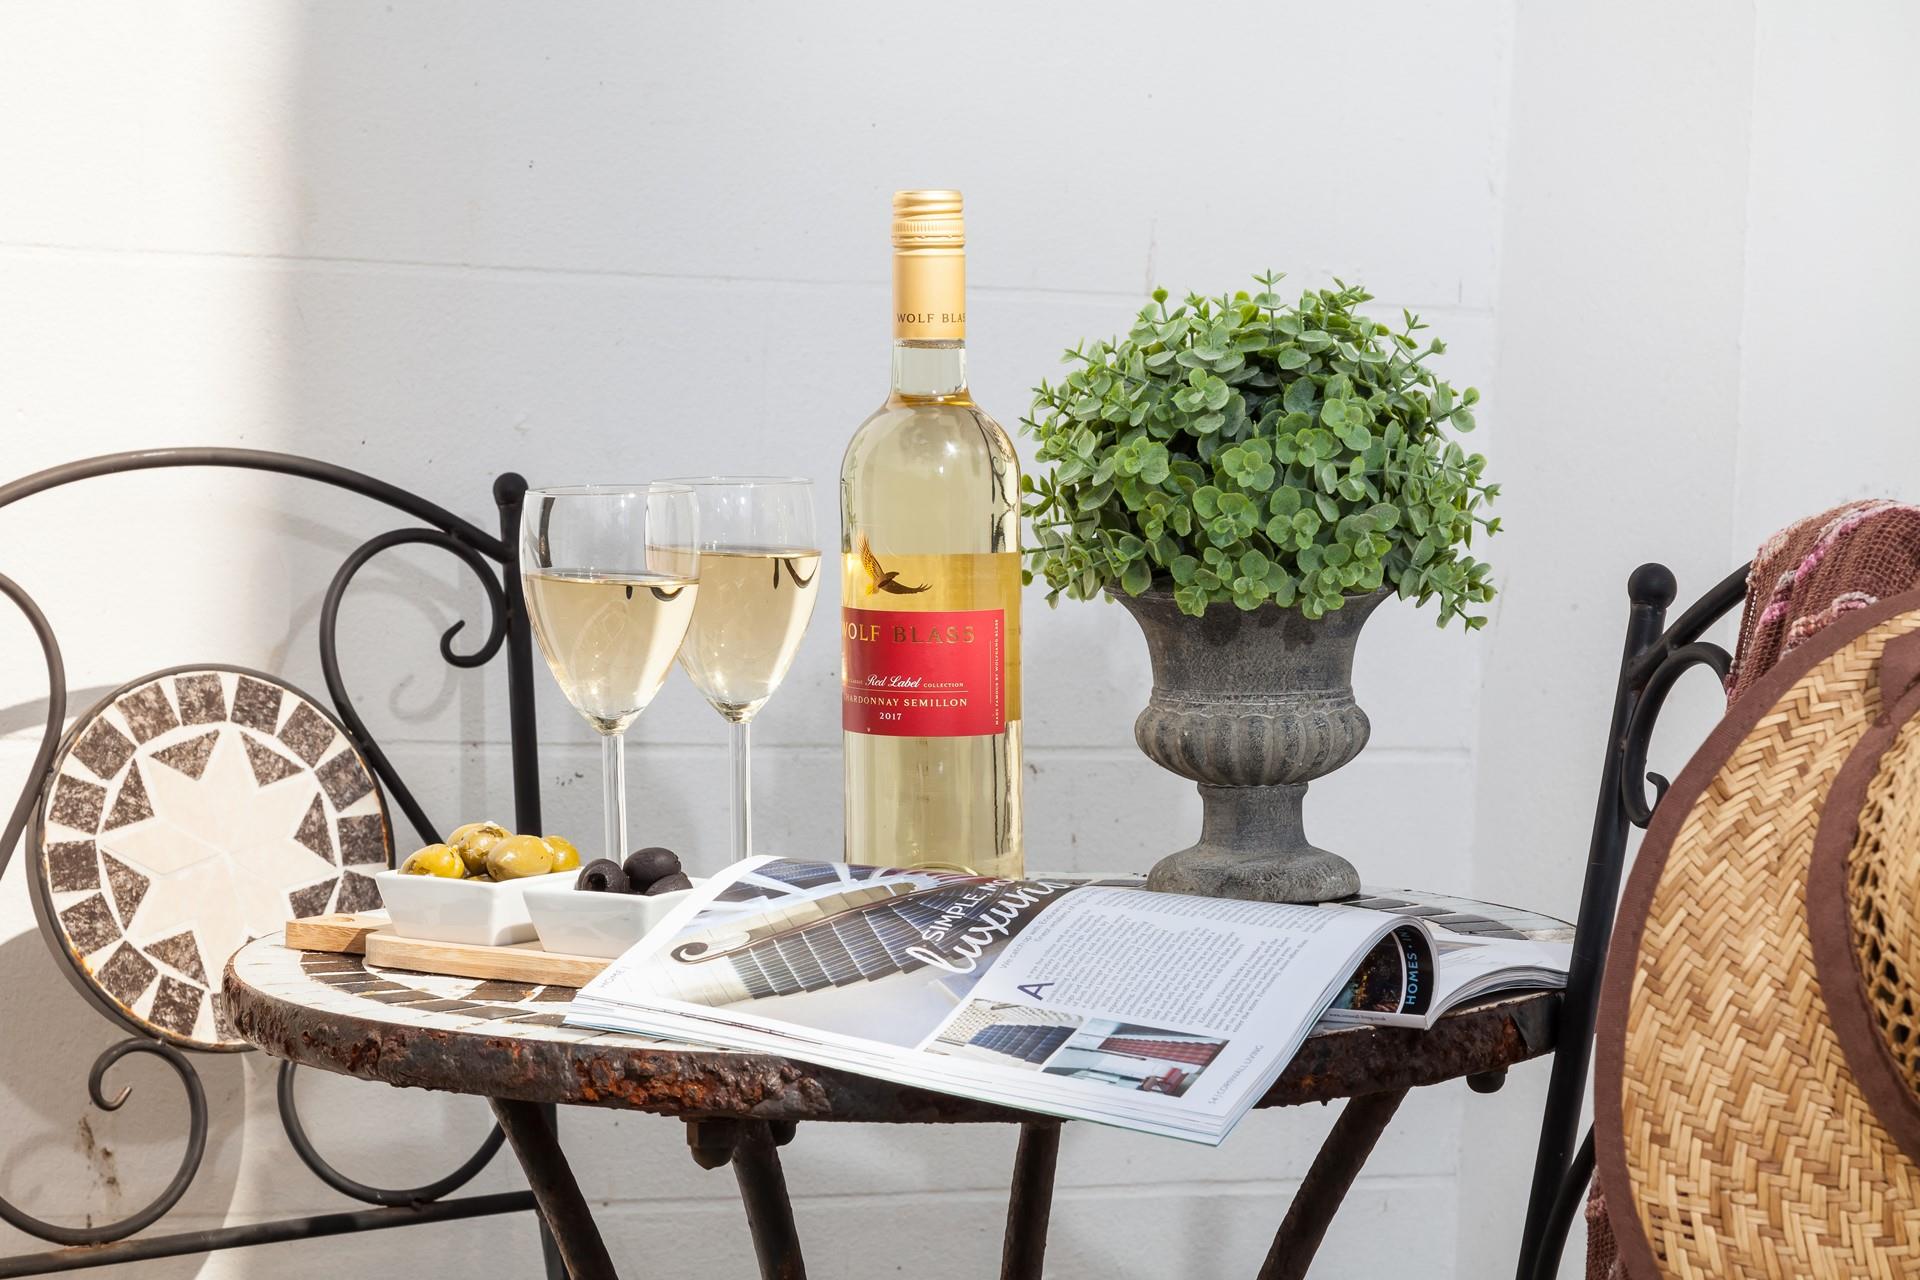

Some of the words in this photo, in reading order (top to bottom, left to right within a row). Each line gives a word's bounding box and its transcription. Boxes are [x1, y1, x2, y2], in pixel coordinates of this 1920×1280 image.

[897, 313, 935, 323] WOLF
[893, 626, 975, 644] BLASS
[865, 673, 887, 687] Red
[888, 674, 922, 688] Label
[843, 693, 899, 706] HARDONNAY
[903, 698, 967, 707] SEMILLON
[879, 712, 902, 721] 2017
[978, 879, 1015, 892] MO
[905, 881, 1070, 974] luxury
[1405, 953, 1418, 1005] HOMES
[1017, 982, 1055, 1001] A
